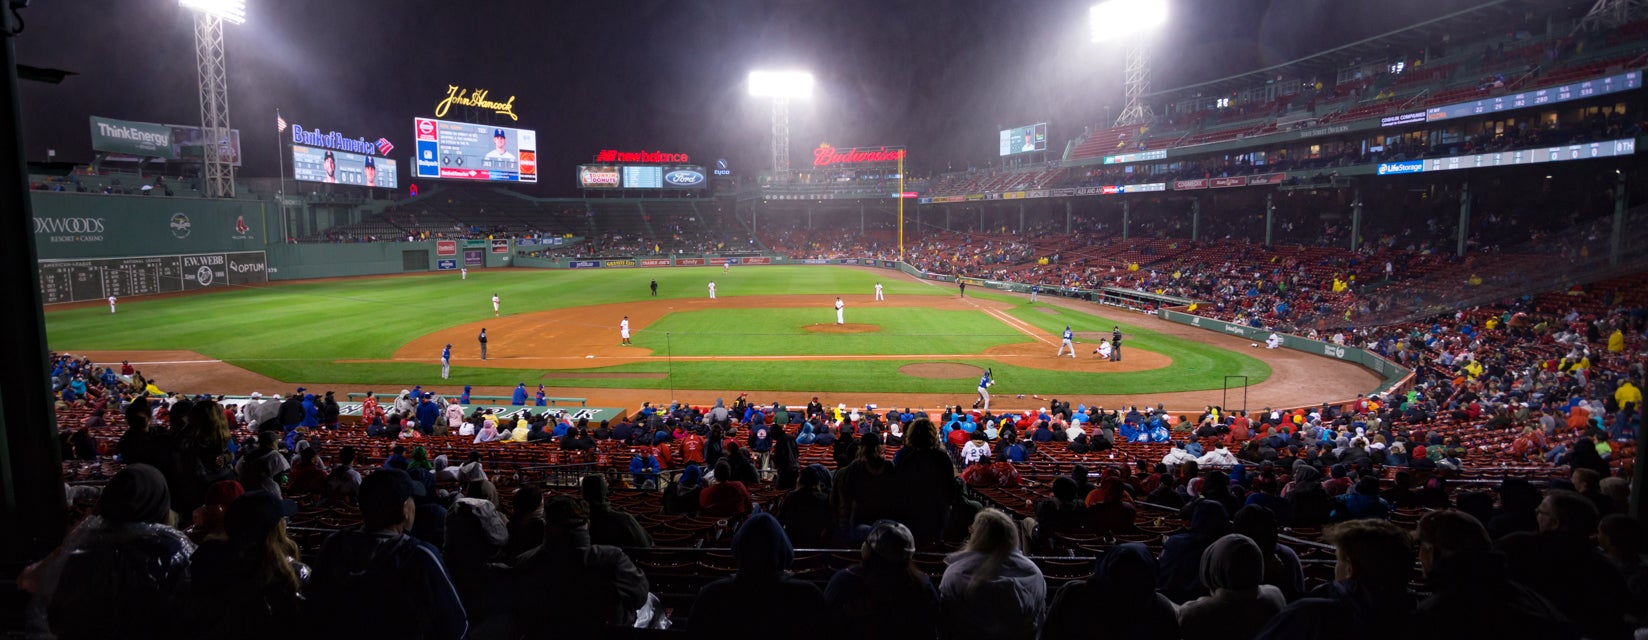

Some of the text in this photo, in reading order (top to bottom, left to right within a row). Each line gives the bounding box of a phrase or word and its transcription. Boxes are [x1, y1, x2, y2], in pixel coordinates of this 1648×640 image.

[435, 84, 518, 121] John Hancock
[97, 122, 169, 147] ThinkEnergy
[292, 124, 376, 155] Bank of America
[1592, 148, 1597, 156] 0
[1617, 142, 1632, 152] 8TH
[618, 152, 641, 162] new
[642, 150, 688, 162] balance
[814, 146, 906, 166] Budweiser
[672, 172, 696, 183] Ford
[200, 256, 223, 265] WEBB
[238, 263, 264, 273] OPTUM
[971, 449, 984, 457] 29
